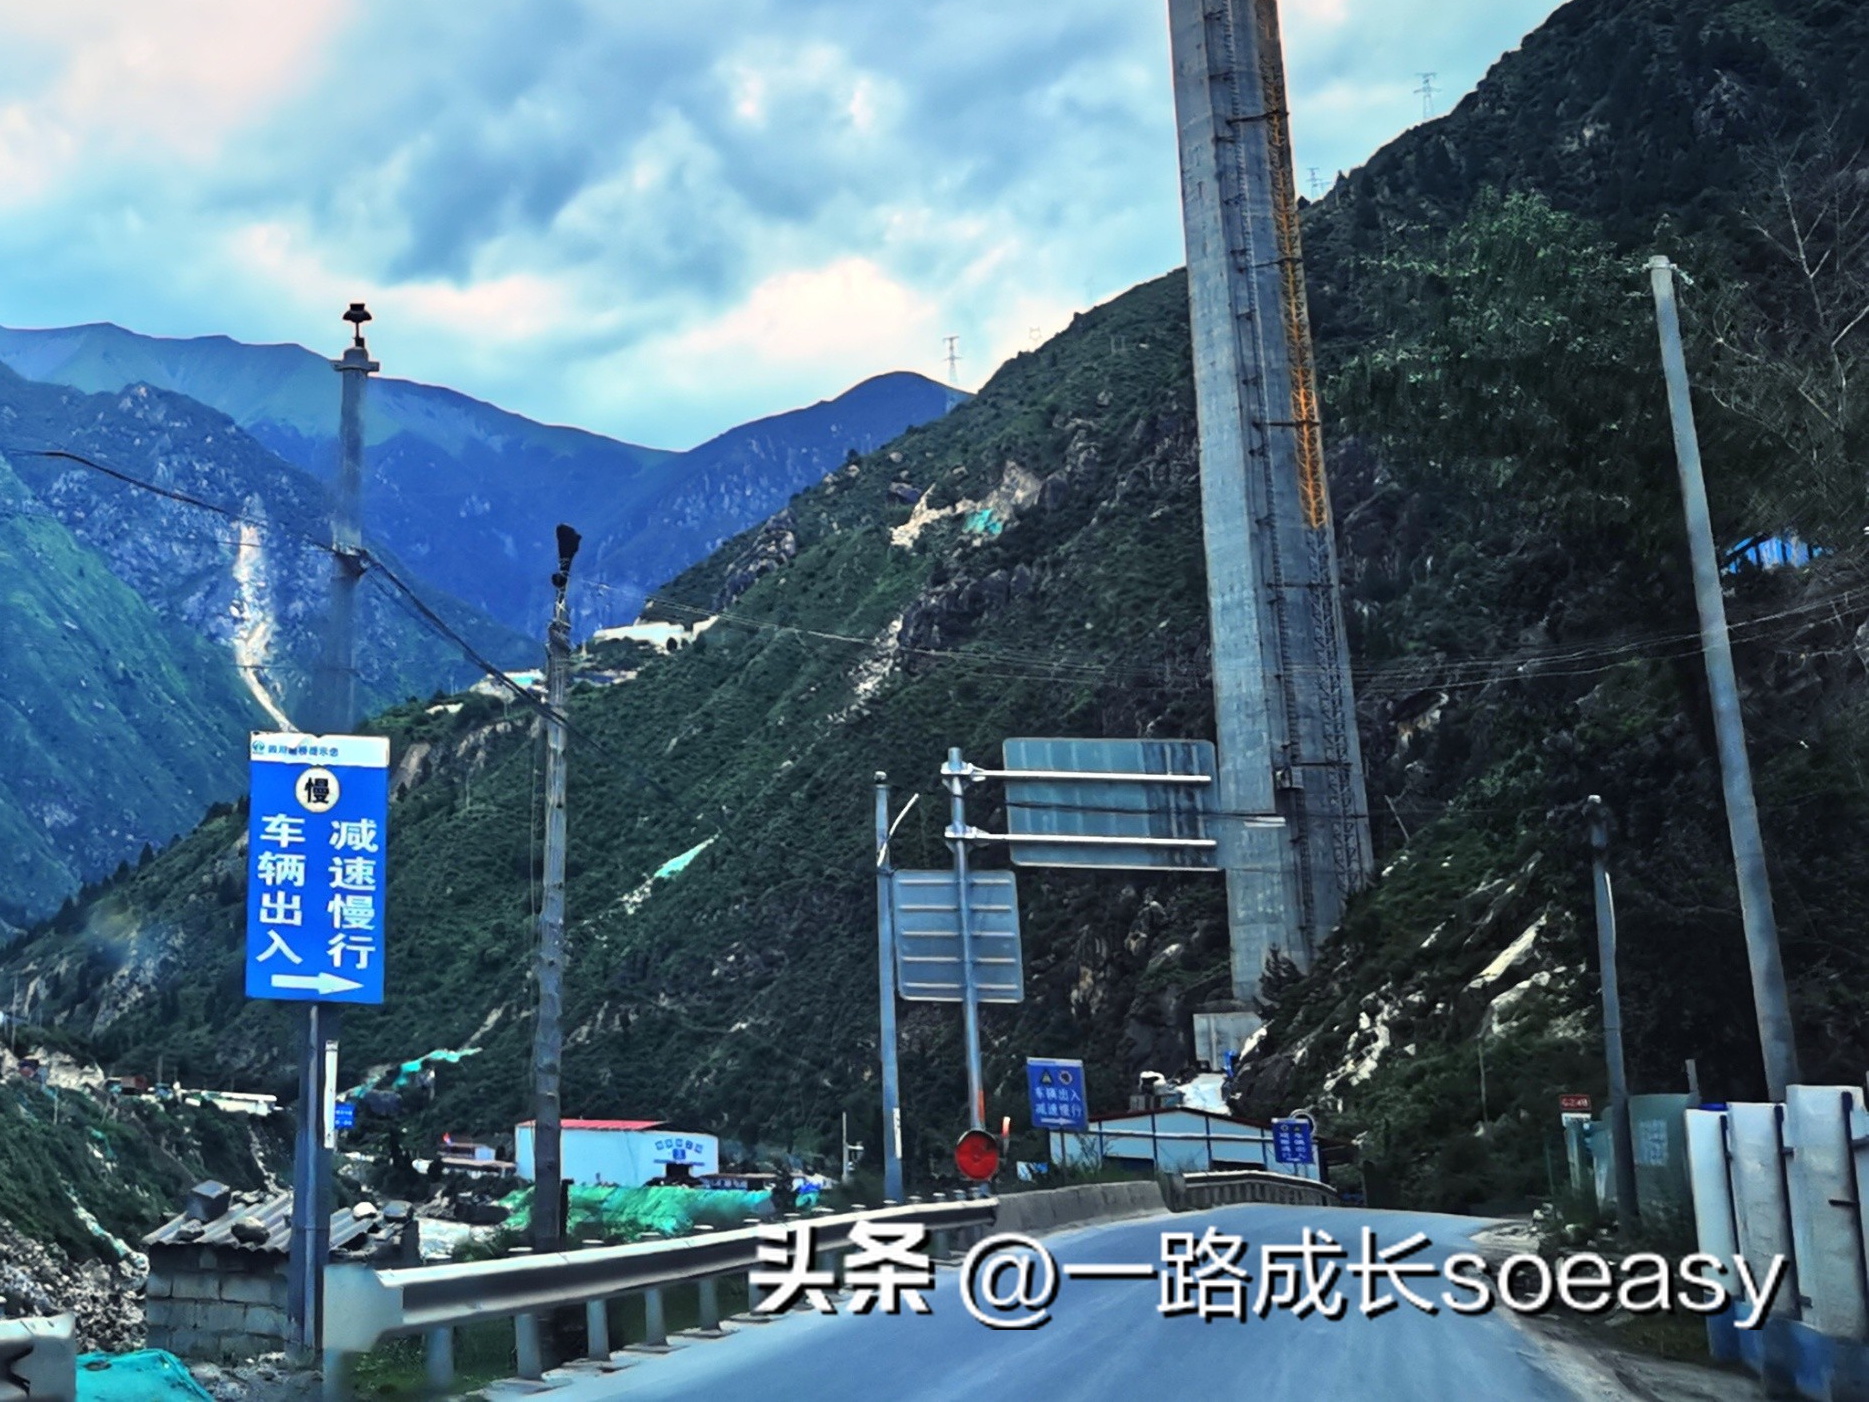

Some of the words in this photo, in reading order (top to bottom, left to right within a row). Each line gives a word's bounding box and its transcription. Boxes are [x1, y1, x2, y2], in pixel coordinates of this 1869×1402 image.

[304, 777, 329, 804] 慢
[256, 813, 306, 965] 车辆出入
[326, 817, 379, 970] 减速慢行
